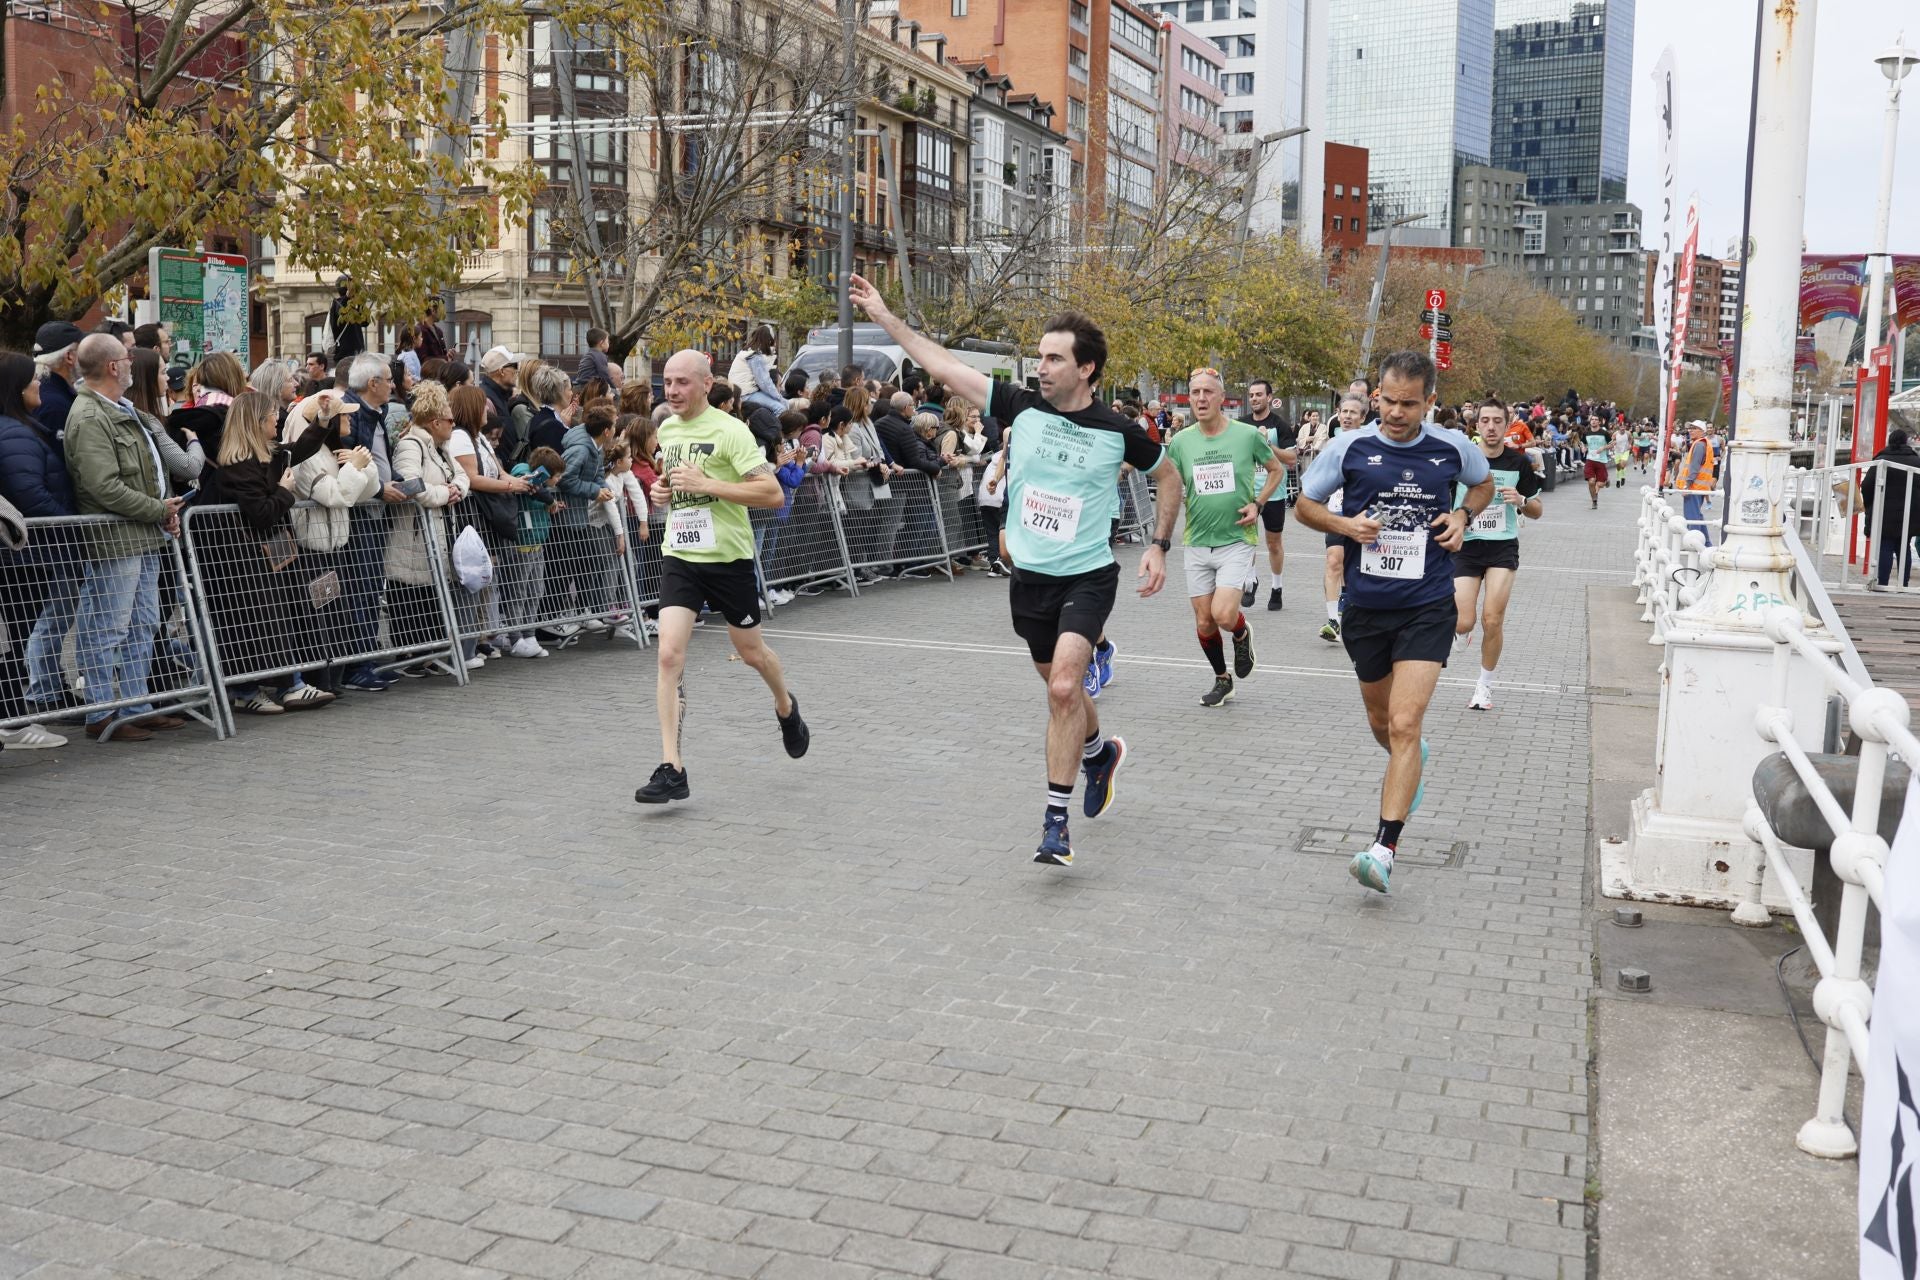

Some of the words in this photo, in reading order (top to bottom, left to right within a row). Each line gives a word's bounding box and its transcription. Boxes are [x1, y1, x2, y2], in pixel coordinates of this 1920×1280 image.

[207, 256, 226, 265] Bilbao
[1801, 262, 1824, 276] Fair
[1801, 271, 1862, 287] Saturday
[240, 320, 248, 352] Bilbao
[1204, 480, 1224, 490] 2433
[1041, 493, 1068, 504] CORREO
[1399, 492, 1436, 500] MARATHON
[1026, 497, 1046, 512] XXXVI
[1047, 509, 1073, 519] BILBAO
[1032, 512, 1059, 532] 2774
[1478, 520, 1497, 529] 1900
[676, 530, 700, 544] 2689
[1380, 556, 1403, 571] 307
